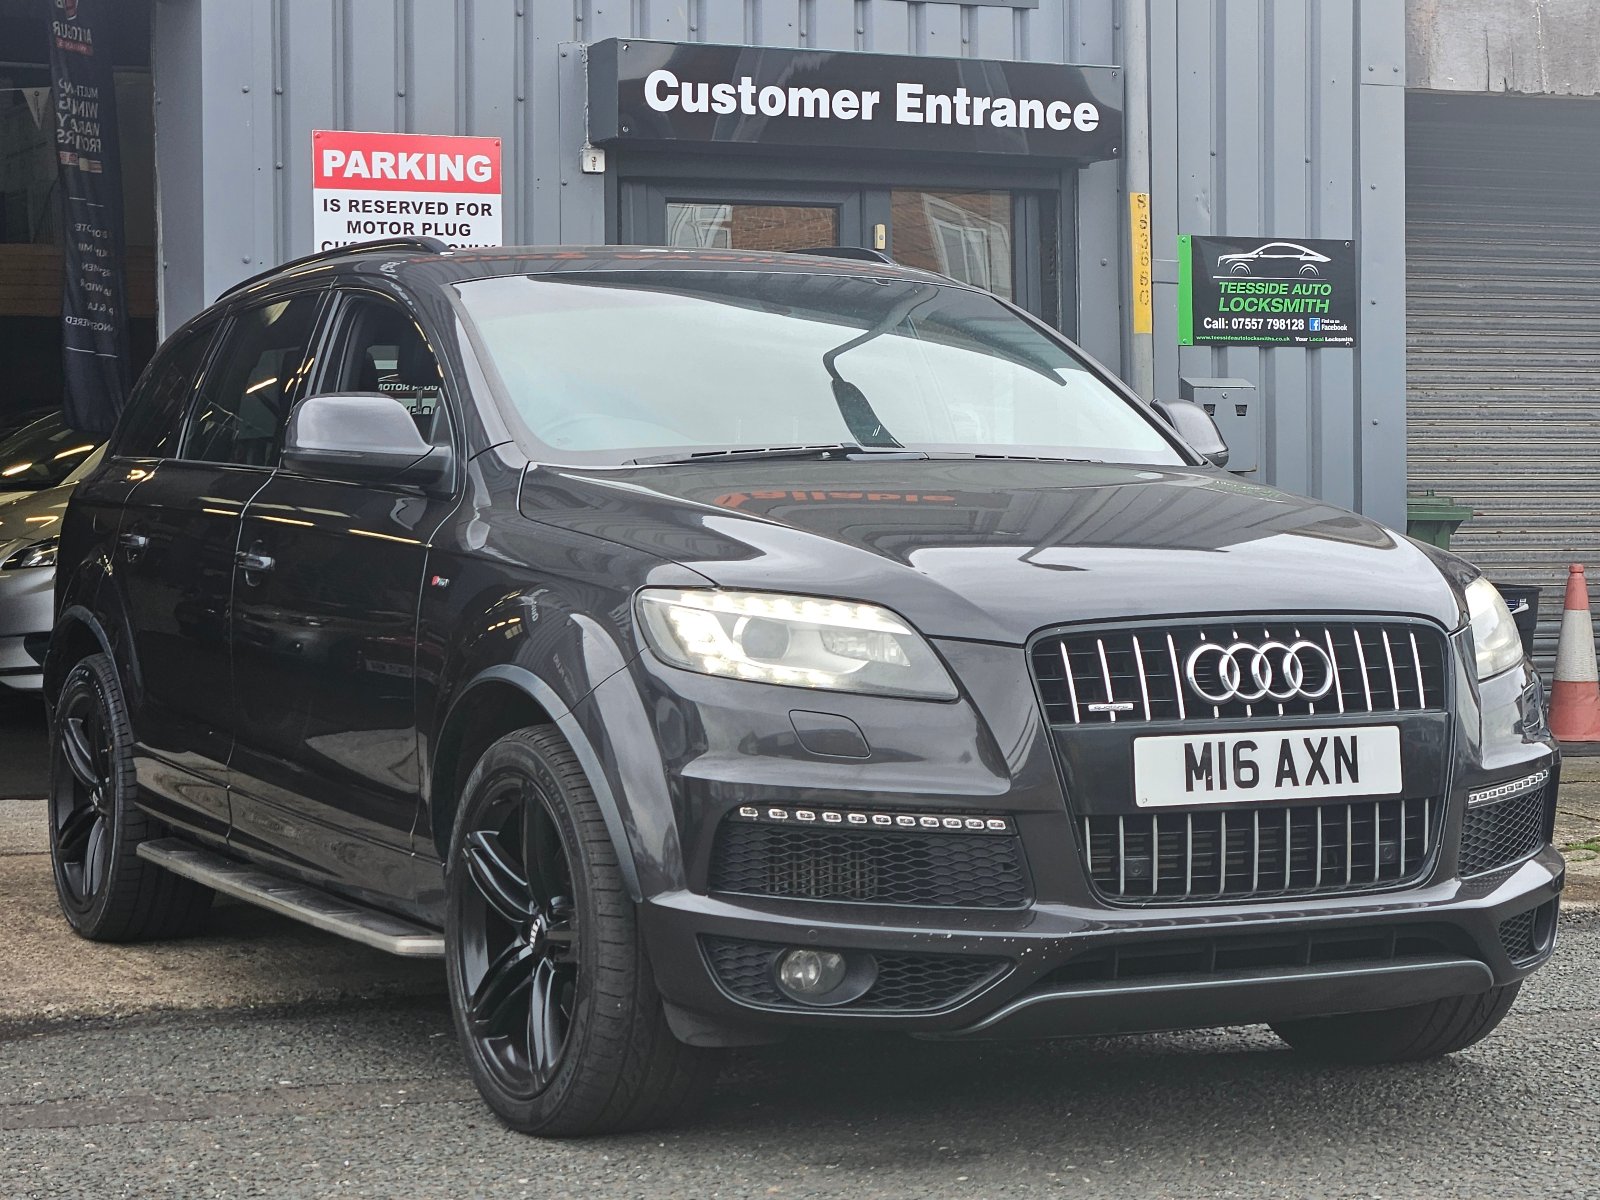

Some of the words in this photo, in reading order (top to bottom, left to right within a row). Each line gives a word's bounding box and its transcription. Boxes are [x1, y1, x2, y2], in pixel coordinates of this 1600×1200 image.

[644, 70, 880, 121] Customer
[896, 82, 1100, 132] Entrance
[322, 149, 492, 183] PARKING
[323, 198, 341, 212] IS
[348, 199, 449, 216] RESERVED
[455, 202, 493, 217] FOR
[347, 220, 415, 236] MOTOR
[422, 222, 471, 237] PLUG
[1219, 281, 1289, 295] TEESSIDE
[1292, 283, 1332, 296] AUTO
[1219, 297, 1330, 314] LOCKSMITH
[1203, 317, 1229, 329] Call:
[1231, 317, 1264, 330] 07557
[1266, 318, 1305, 330] 798128
[1184, 739, 1260, 793] M16
[1275, 735, 1360, 789] AXN
